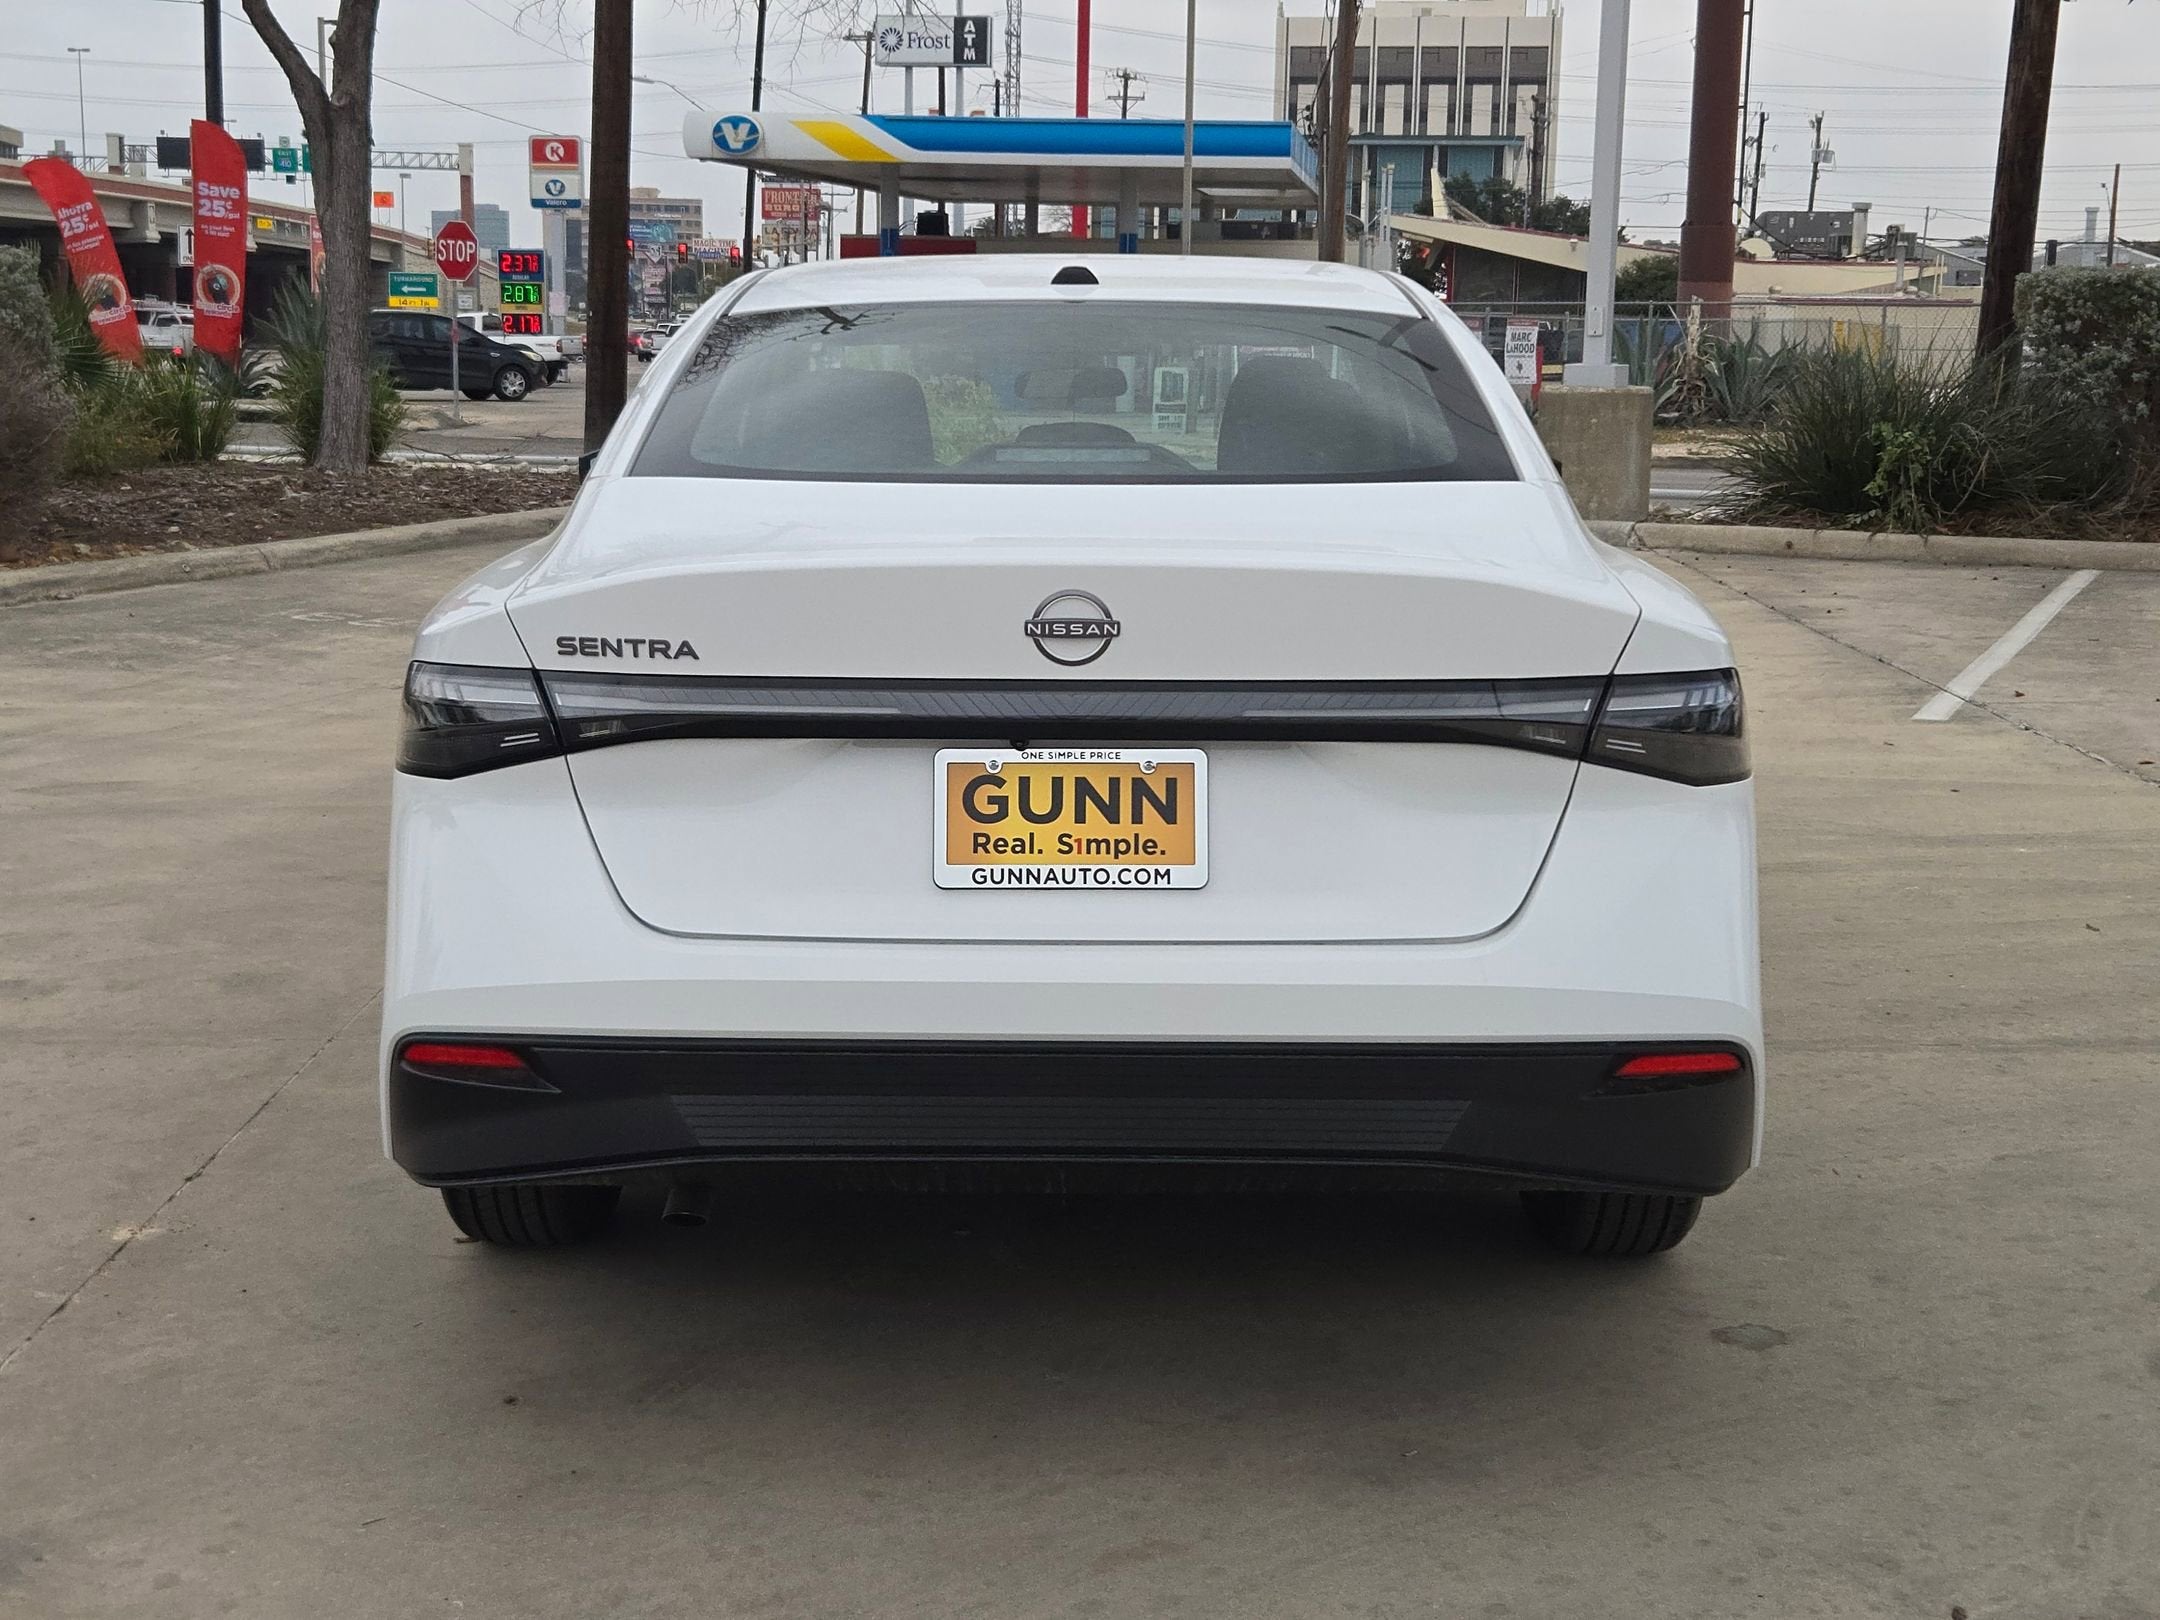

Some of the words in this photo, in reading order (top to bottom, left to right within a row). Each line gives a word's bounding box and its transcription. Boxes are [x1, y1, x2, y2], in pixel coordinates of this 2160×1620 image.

[907, 31, 951, 49] Frost
[963, 20, 976, 61] ATM
[198, 182, 240, 199] Save
[438, 239, 475, 263] STOP
[694, 239, 717, 248] MAGIC
[1510, 331, 1533, 343] MARC
[1027, 623, 1118, 635] NISSAN
[556, 636, 700, 660] SENTRA
[1021, 751, 1044, 760] ONE
[1048, 751, 1086, 760] SIMPLE
[1090, 752, 1121, 760] PRICE
[962, 774, 1178, 825] GUNN
[972, 832, 1043, 855] Real.
[971, 868, 1171, 885] GUNNAUTO.COM
